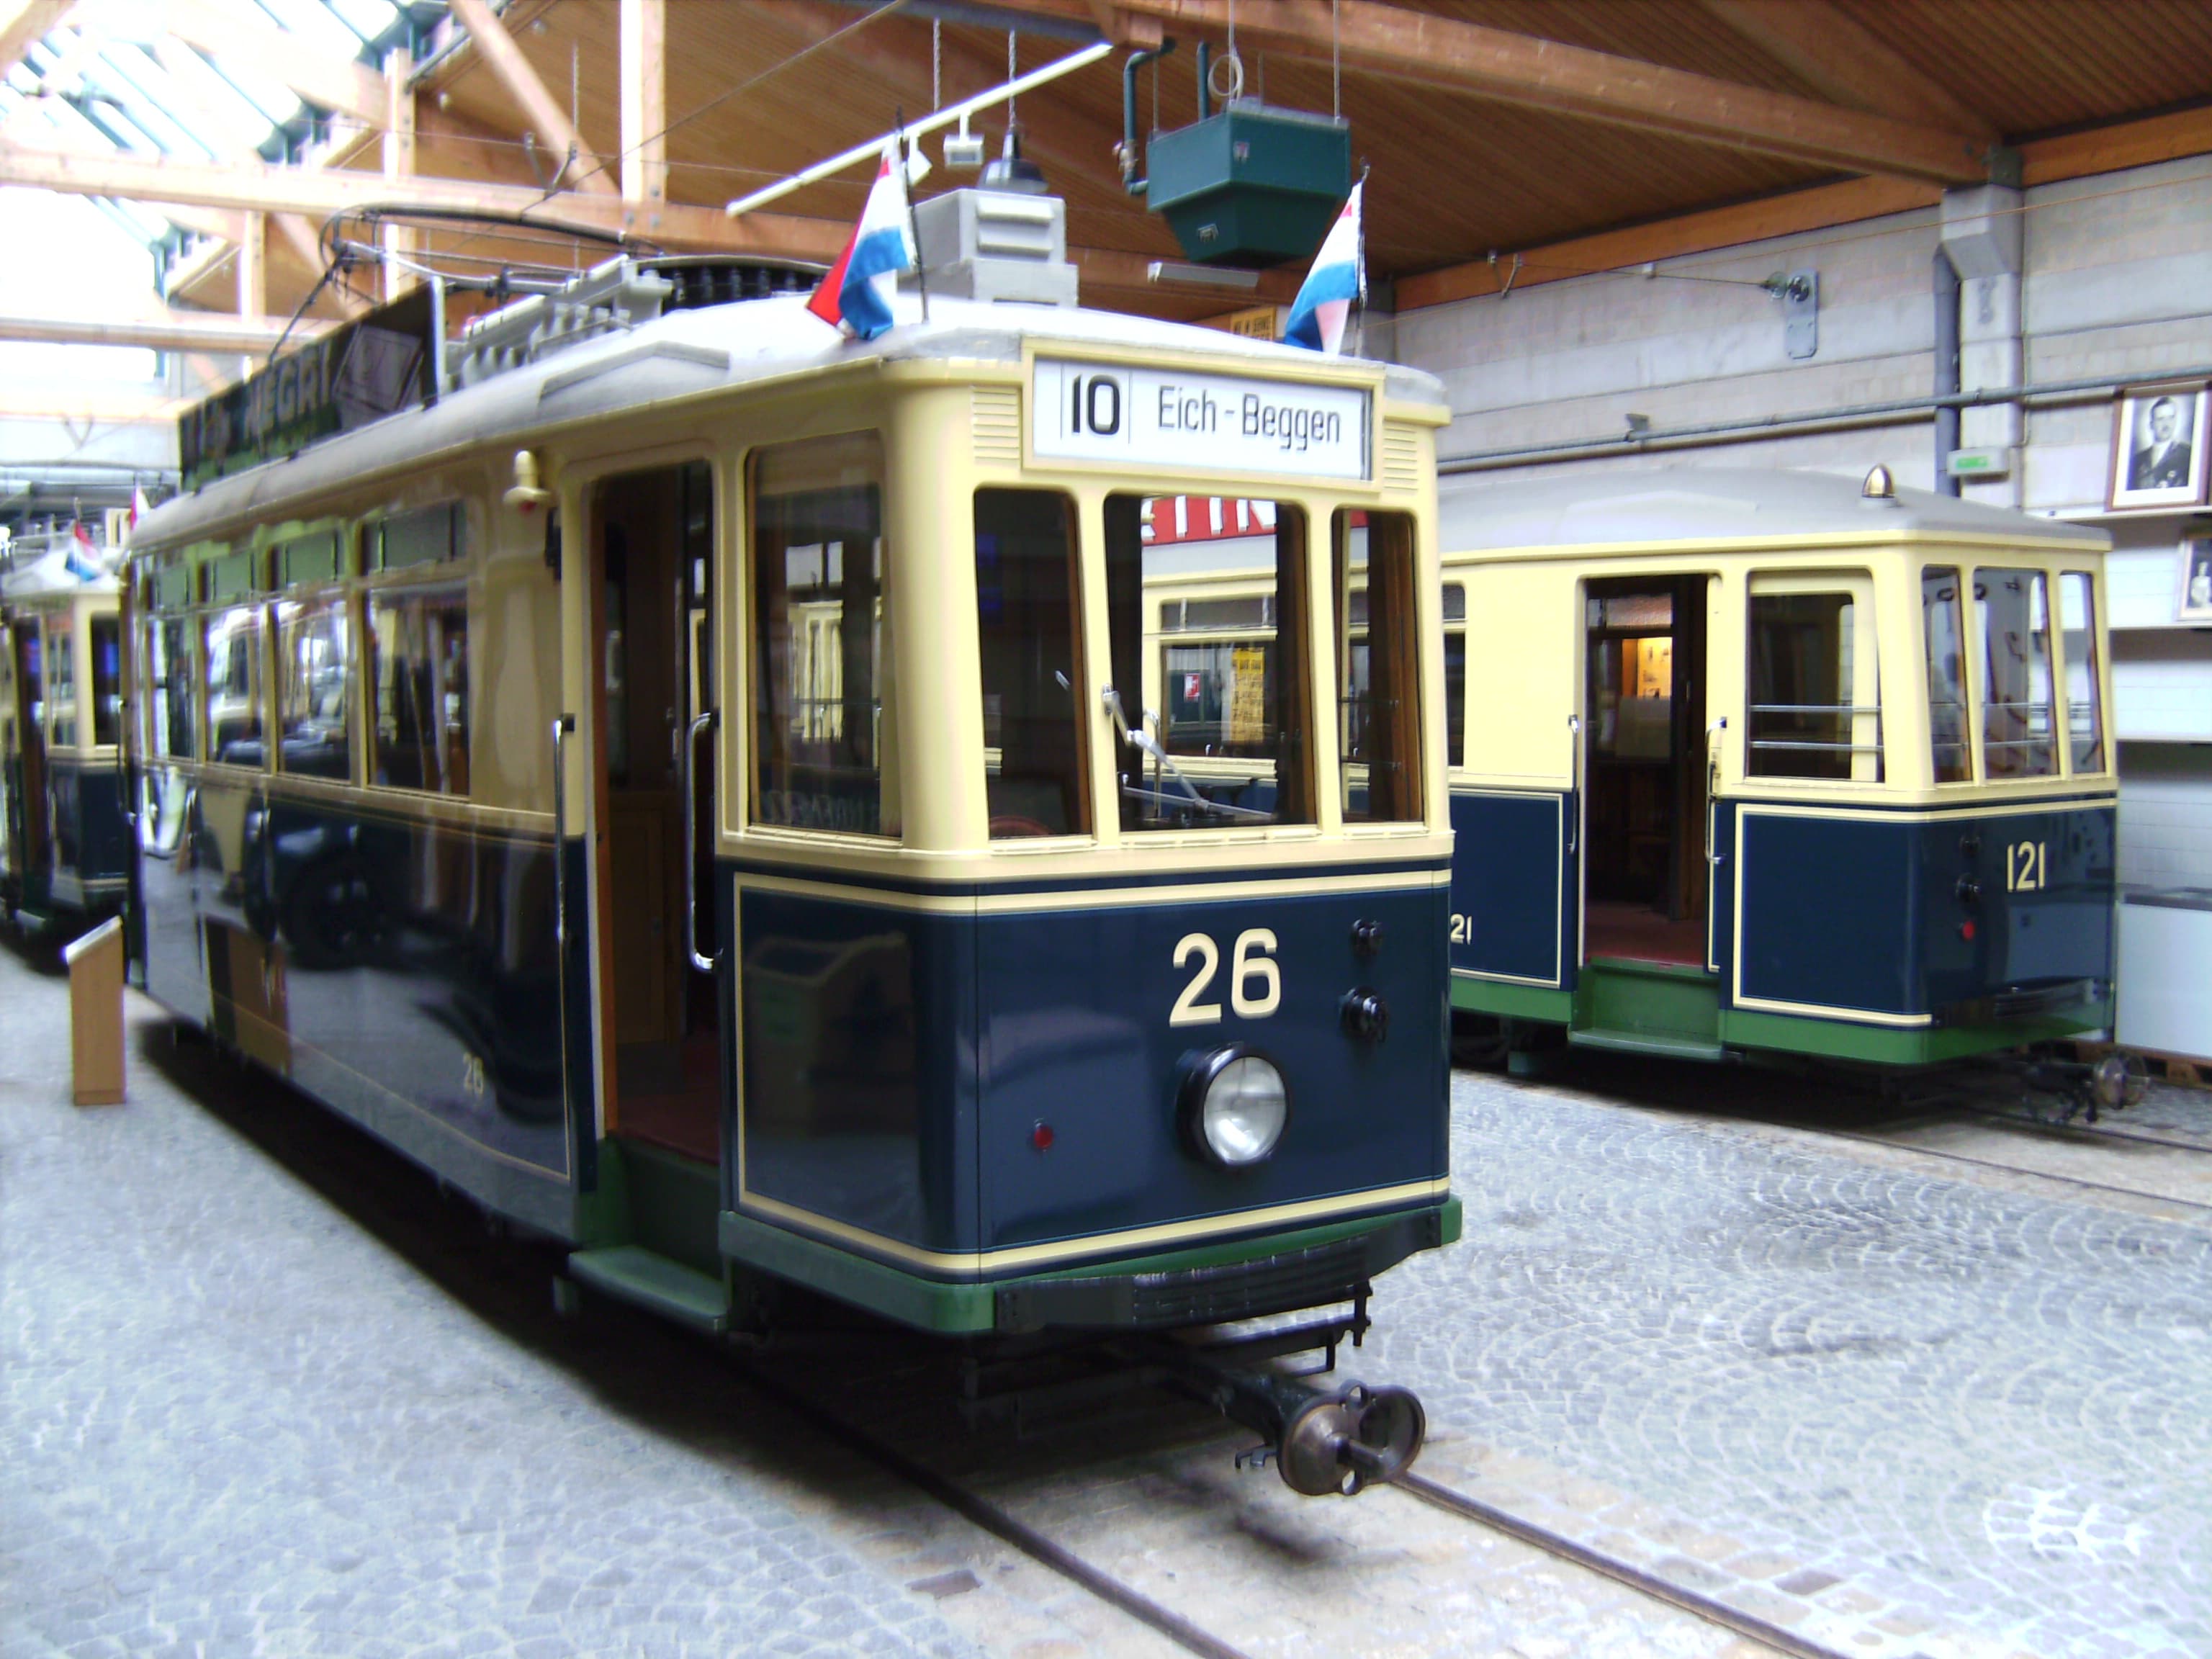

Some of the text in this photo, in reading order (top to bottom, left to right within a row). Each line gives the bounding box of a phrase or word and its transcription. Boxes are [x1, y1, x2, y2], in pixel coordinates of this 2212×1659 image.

[1071, 373, 1121, 436] 10
[2006, 841, 2046, 893] 121
[1450, 913, 1473, 945] 21
[1169, 927, 1281, 1028] 26
